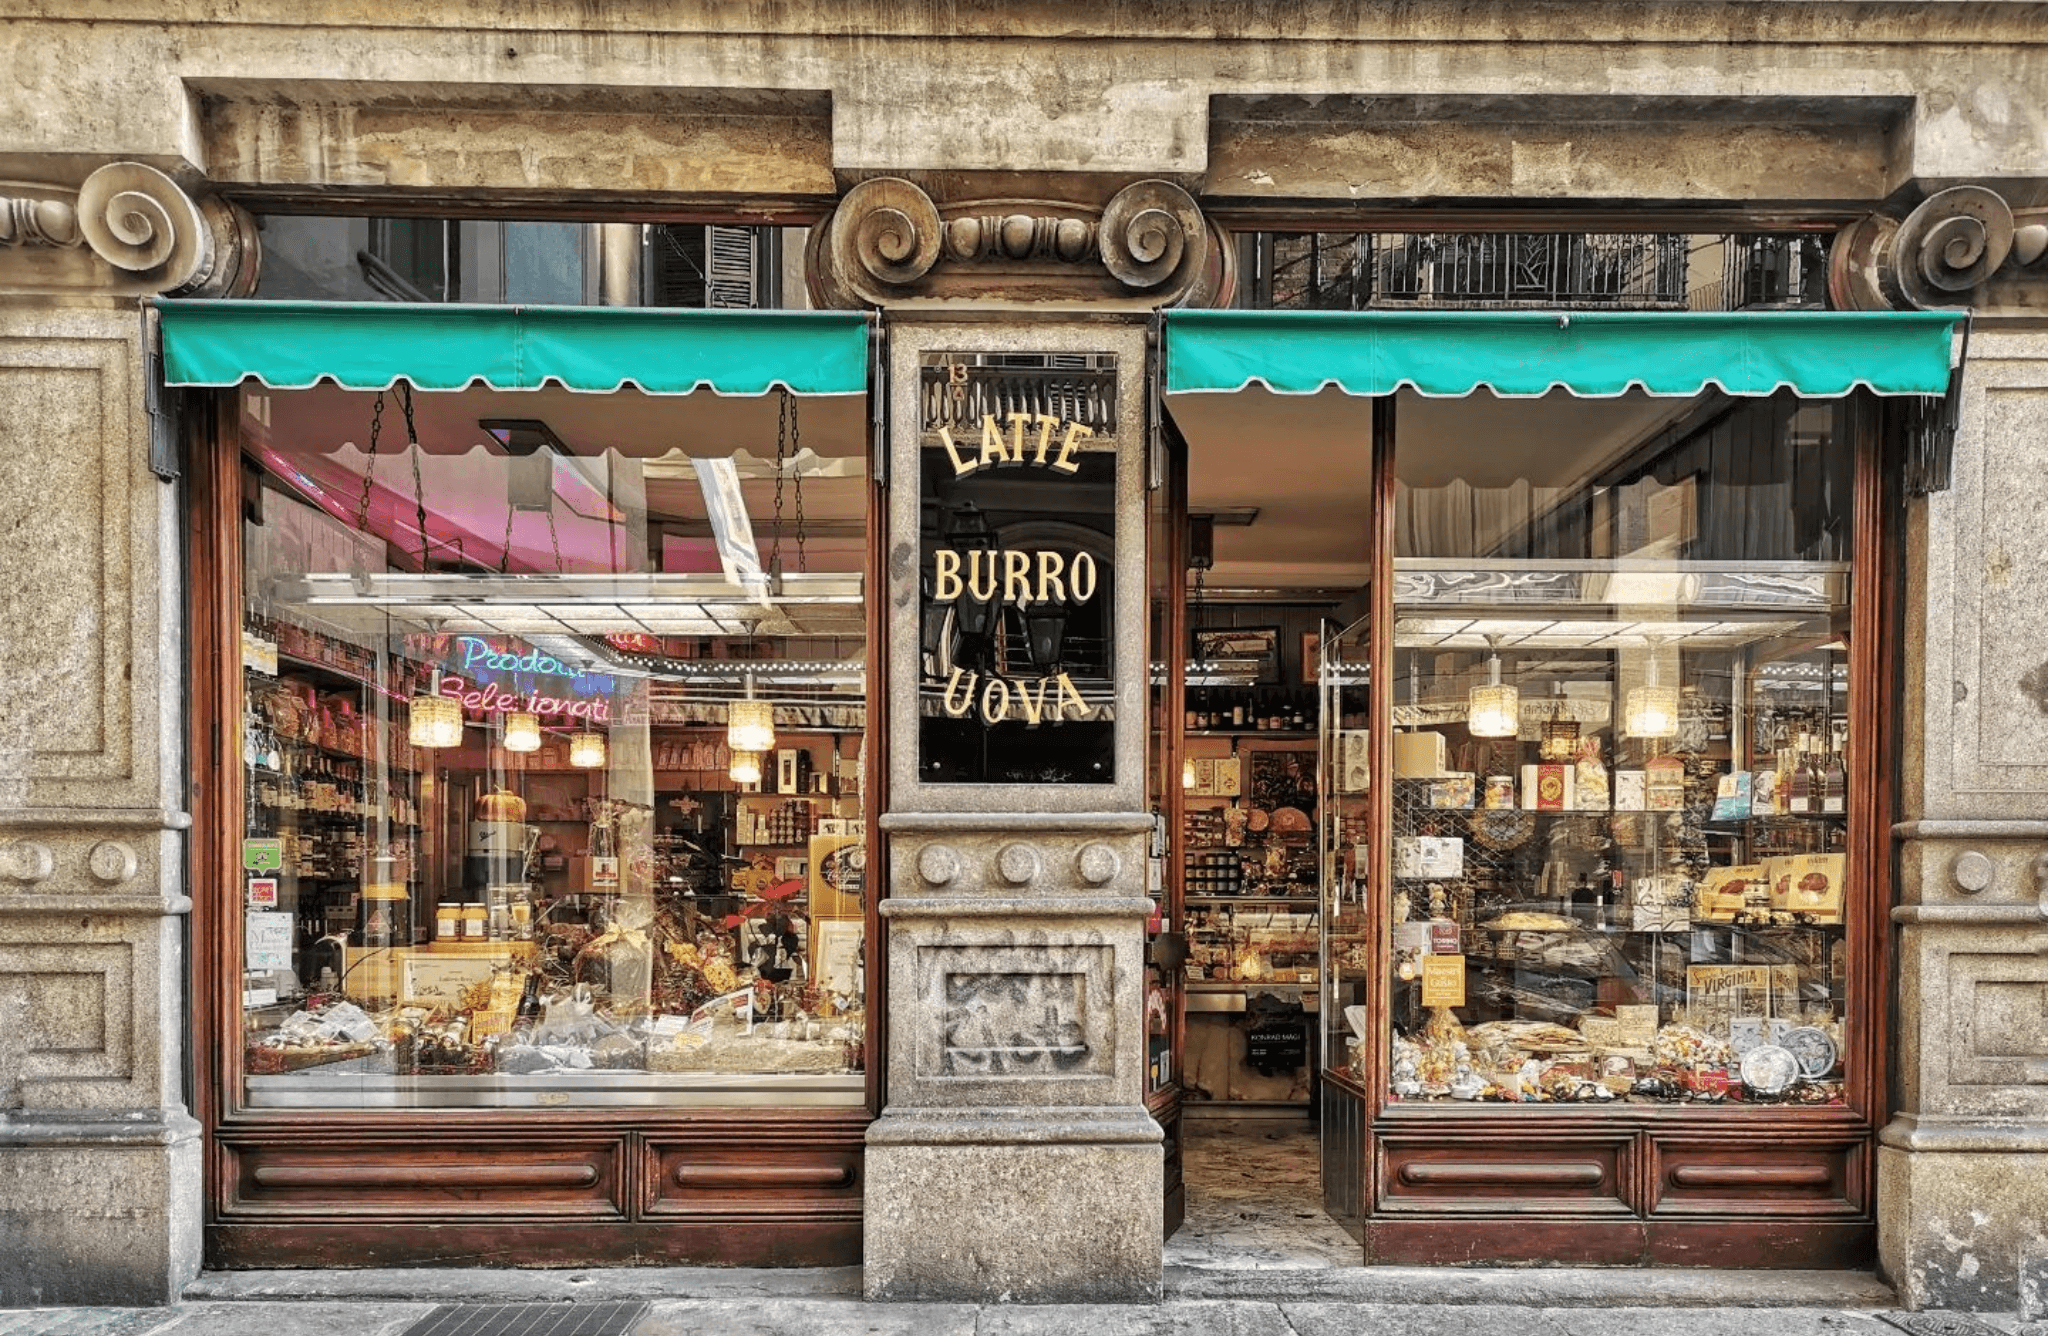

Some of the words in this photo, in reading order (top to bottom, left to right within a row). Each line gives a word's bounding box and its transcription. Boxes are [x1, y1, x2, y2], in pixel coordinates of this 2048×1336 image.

[947, 363, 968, 383] 13
[938, 411, 1094, 477] LATTE
[934, 549, 1098, 603] BURRO
[943, 665, 1092, 727] UOVA
[1704, 969, 1757, 995] VIRGINIA
